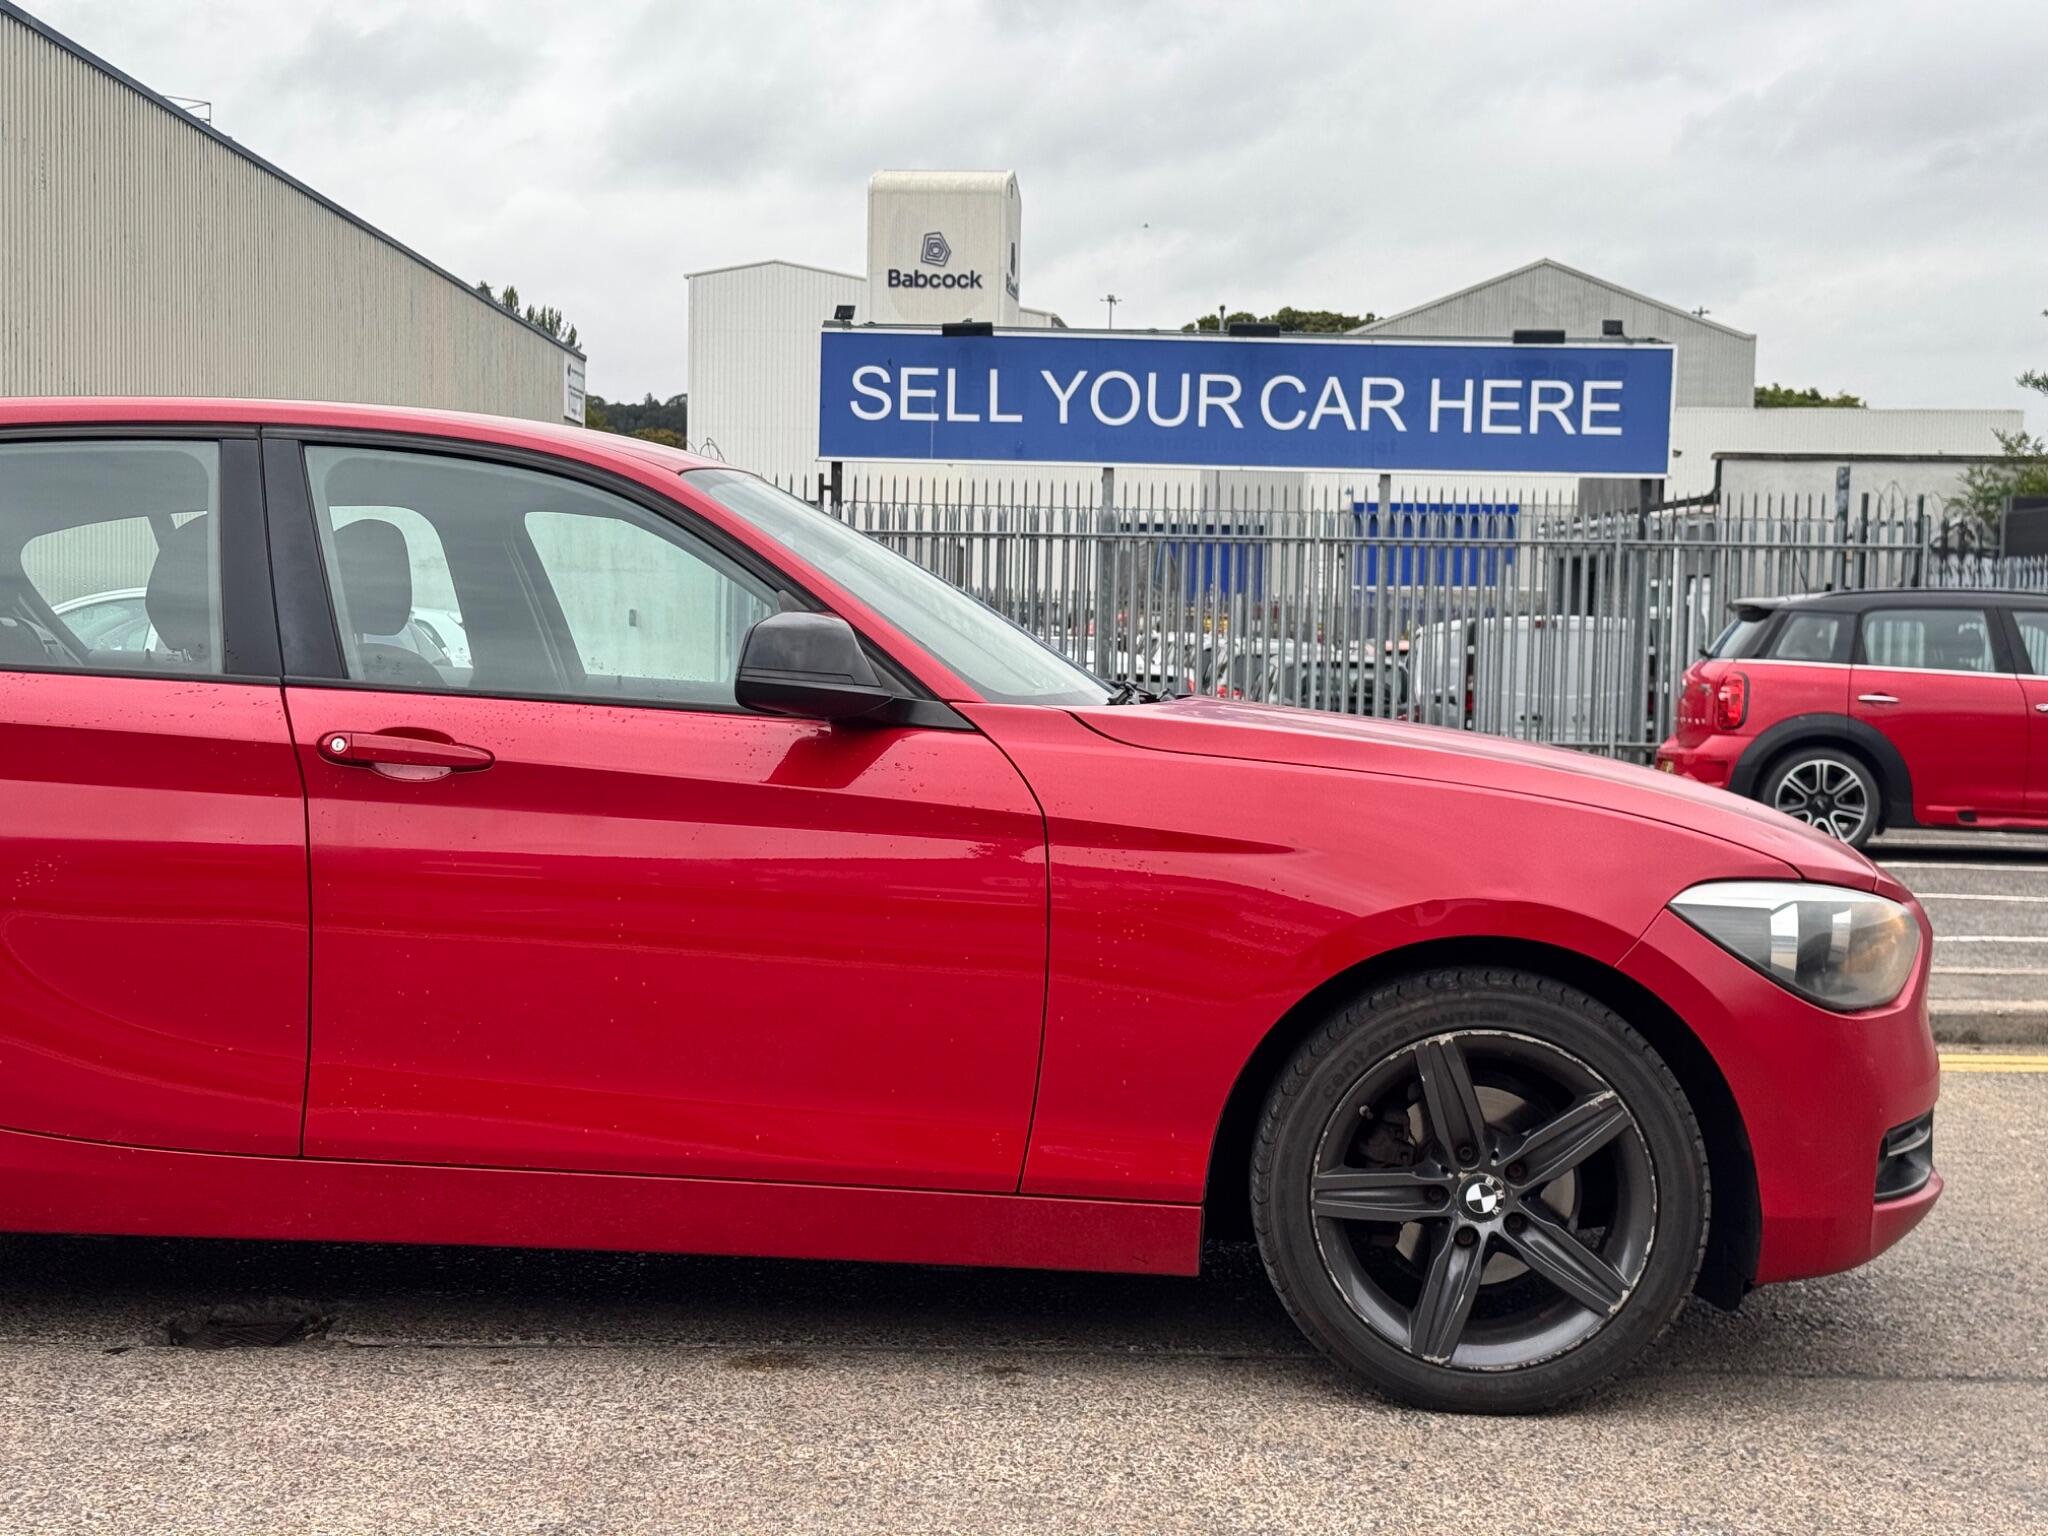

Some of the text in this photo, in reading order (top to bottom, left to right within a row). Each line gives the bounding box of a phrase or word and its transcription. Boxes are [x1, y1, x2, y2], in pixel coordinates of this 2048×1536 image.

[888, 269, 982, 289] Babcock
[850, 365, 1624, 436] SELL YOUR CAR HERE
[1485, 1175, 1504, 1216] BMW
